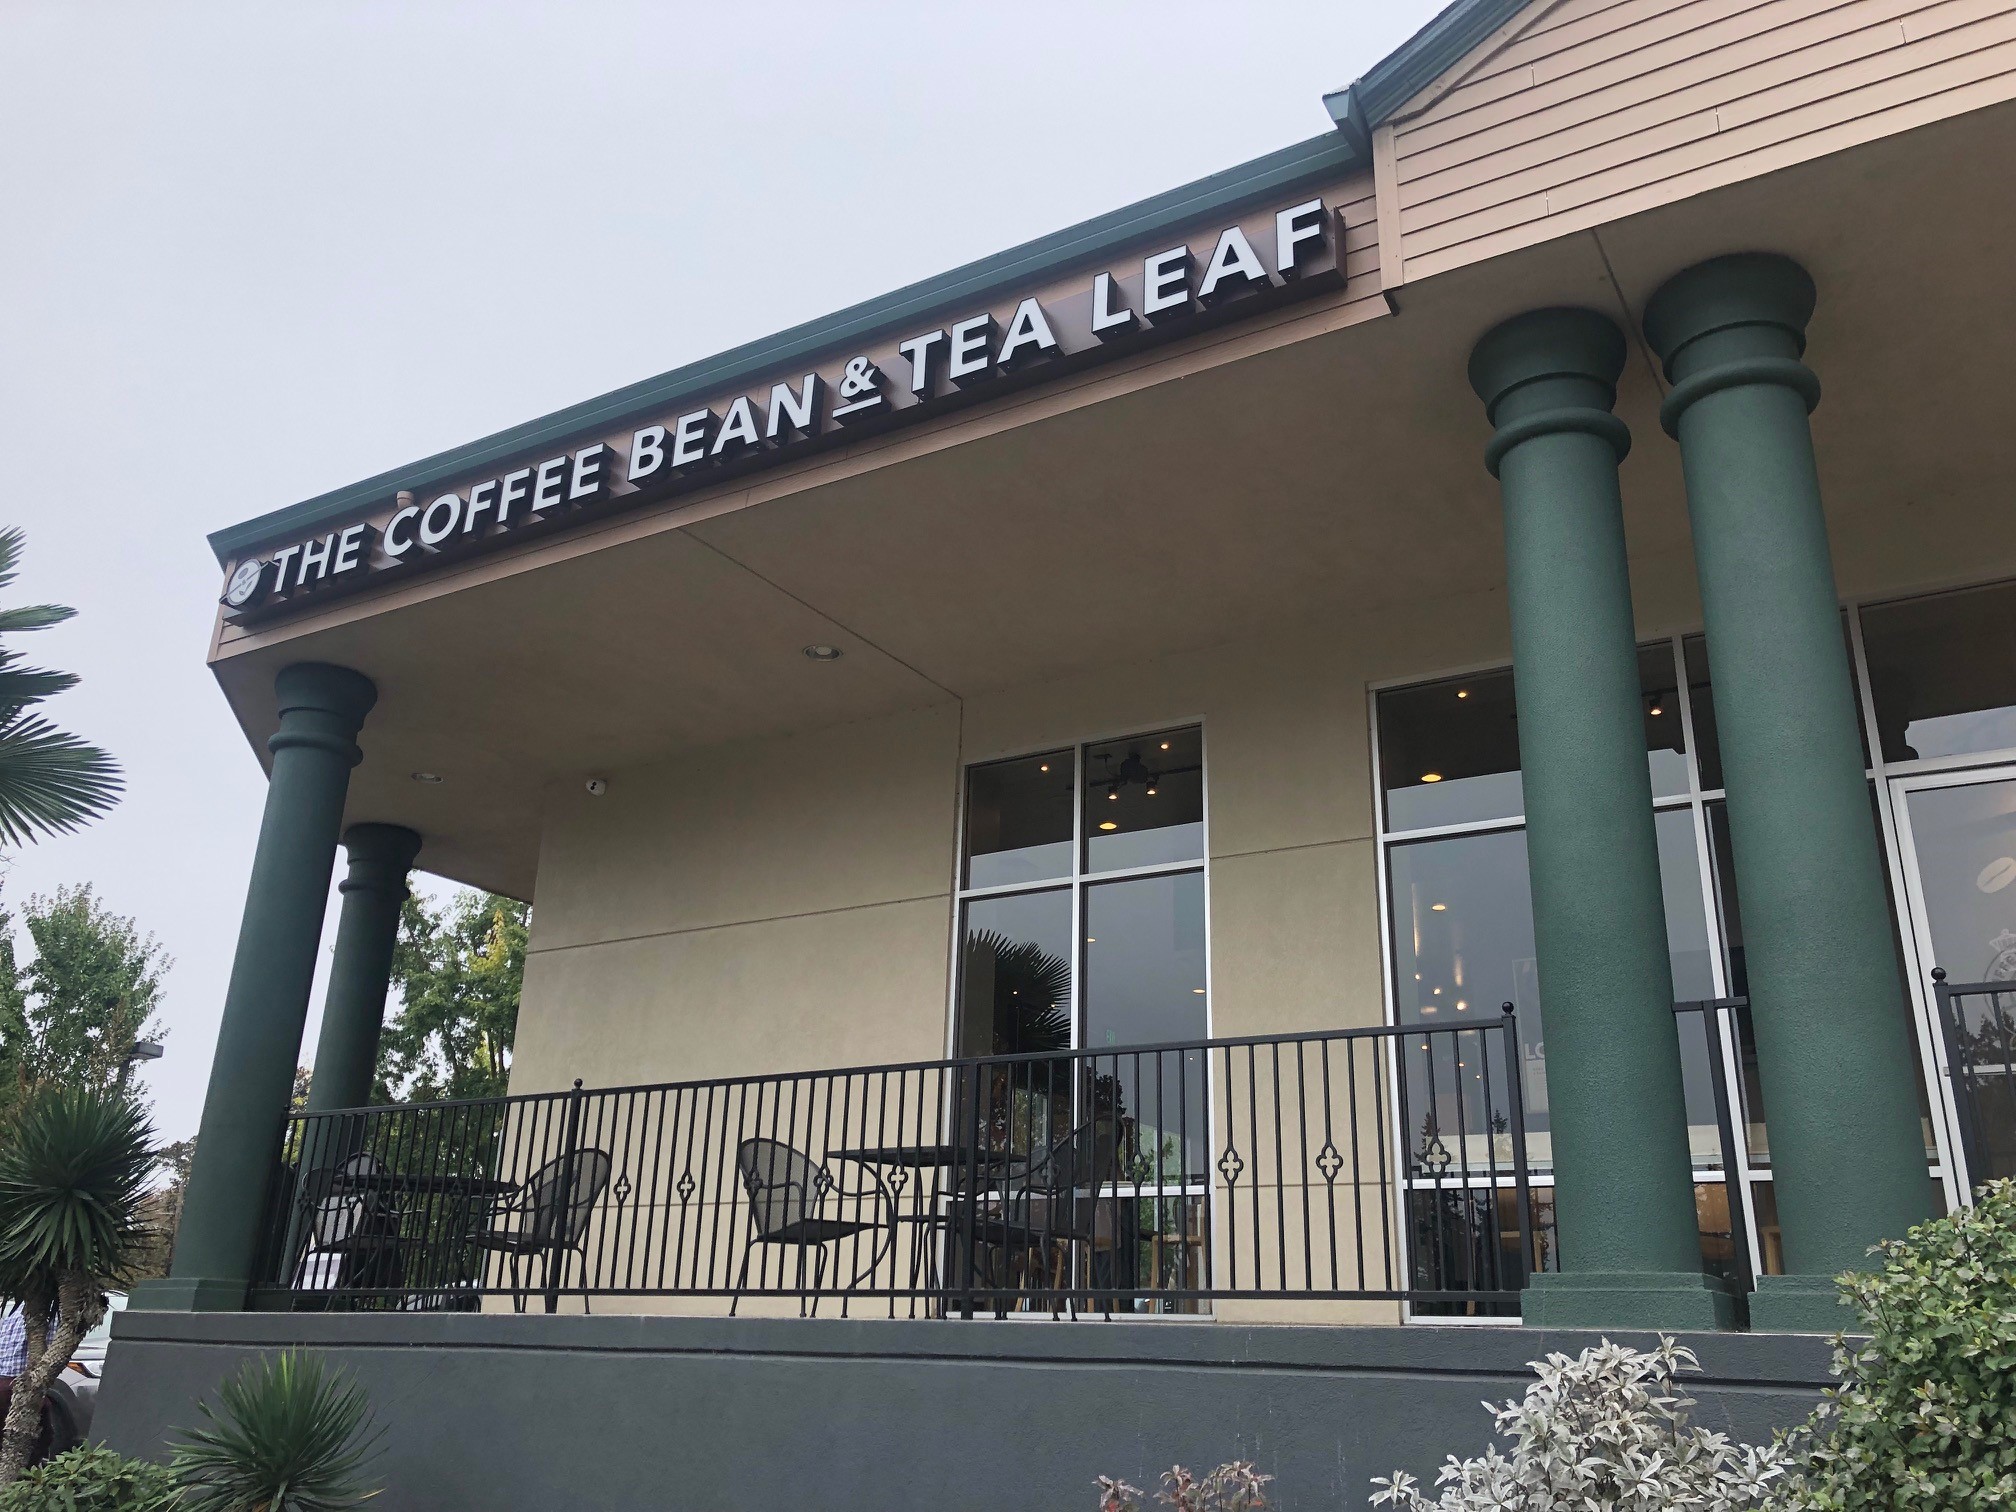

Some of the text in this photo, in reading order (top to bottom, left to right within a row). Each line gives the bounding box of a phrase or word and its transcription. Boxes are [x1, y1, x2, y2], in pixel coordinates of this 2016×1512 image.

[273, 198, 1322, 593] THE COFFEE BEAN & TEA LEAF
